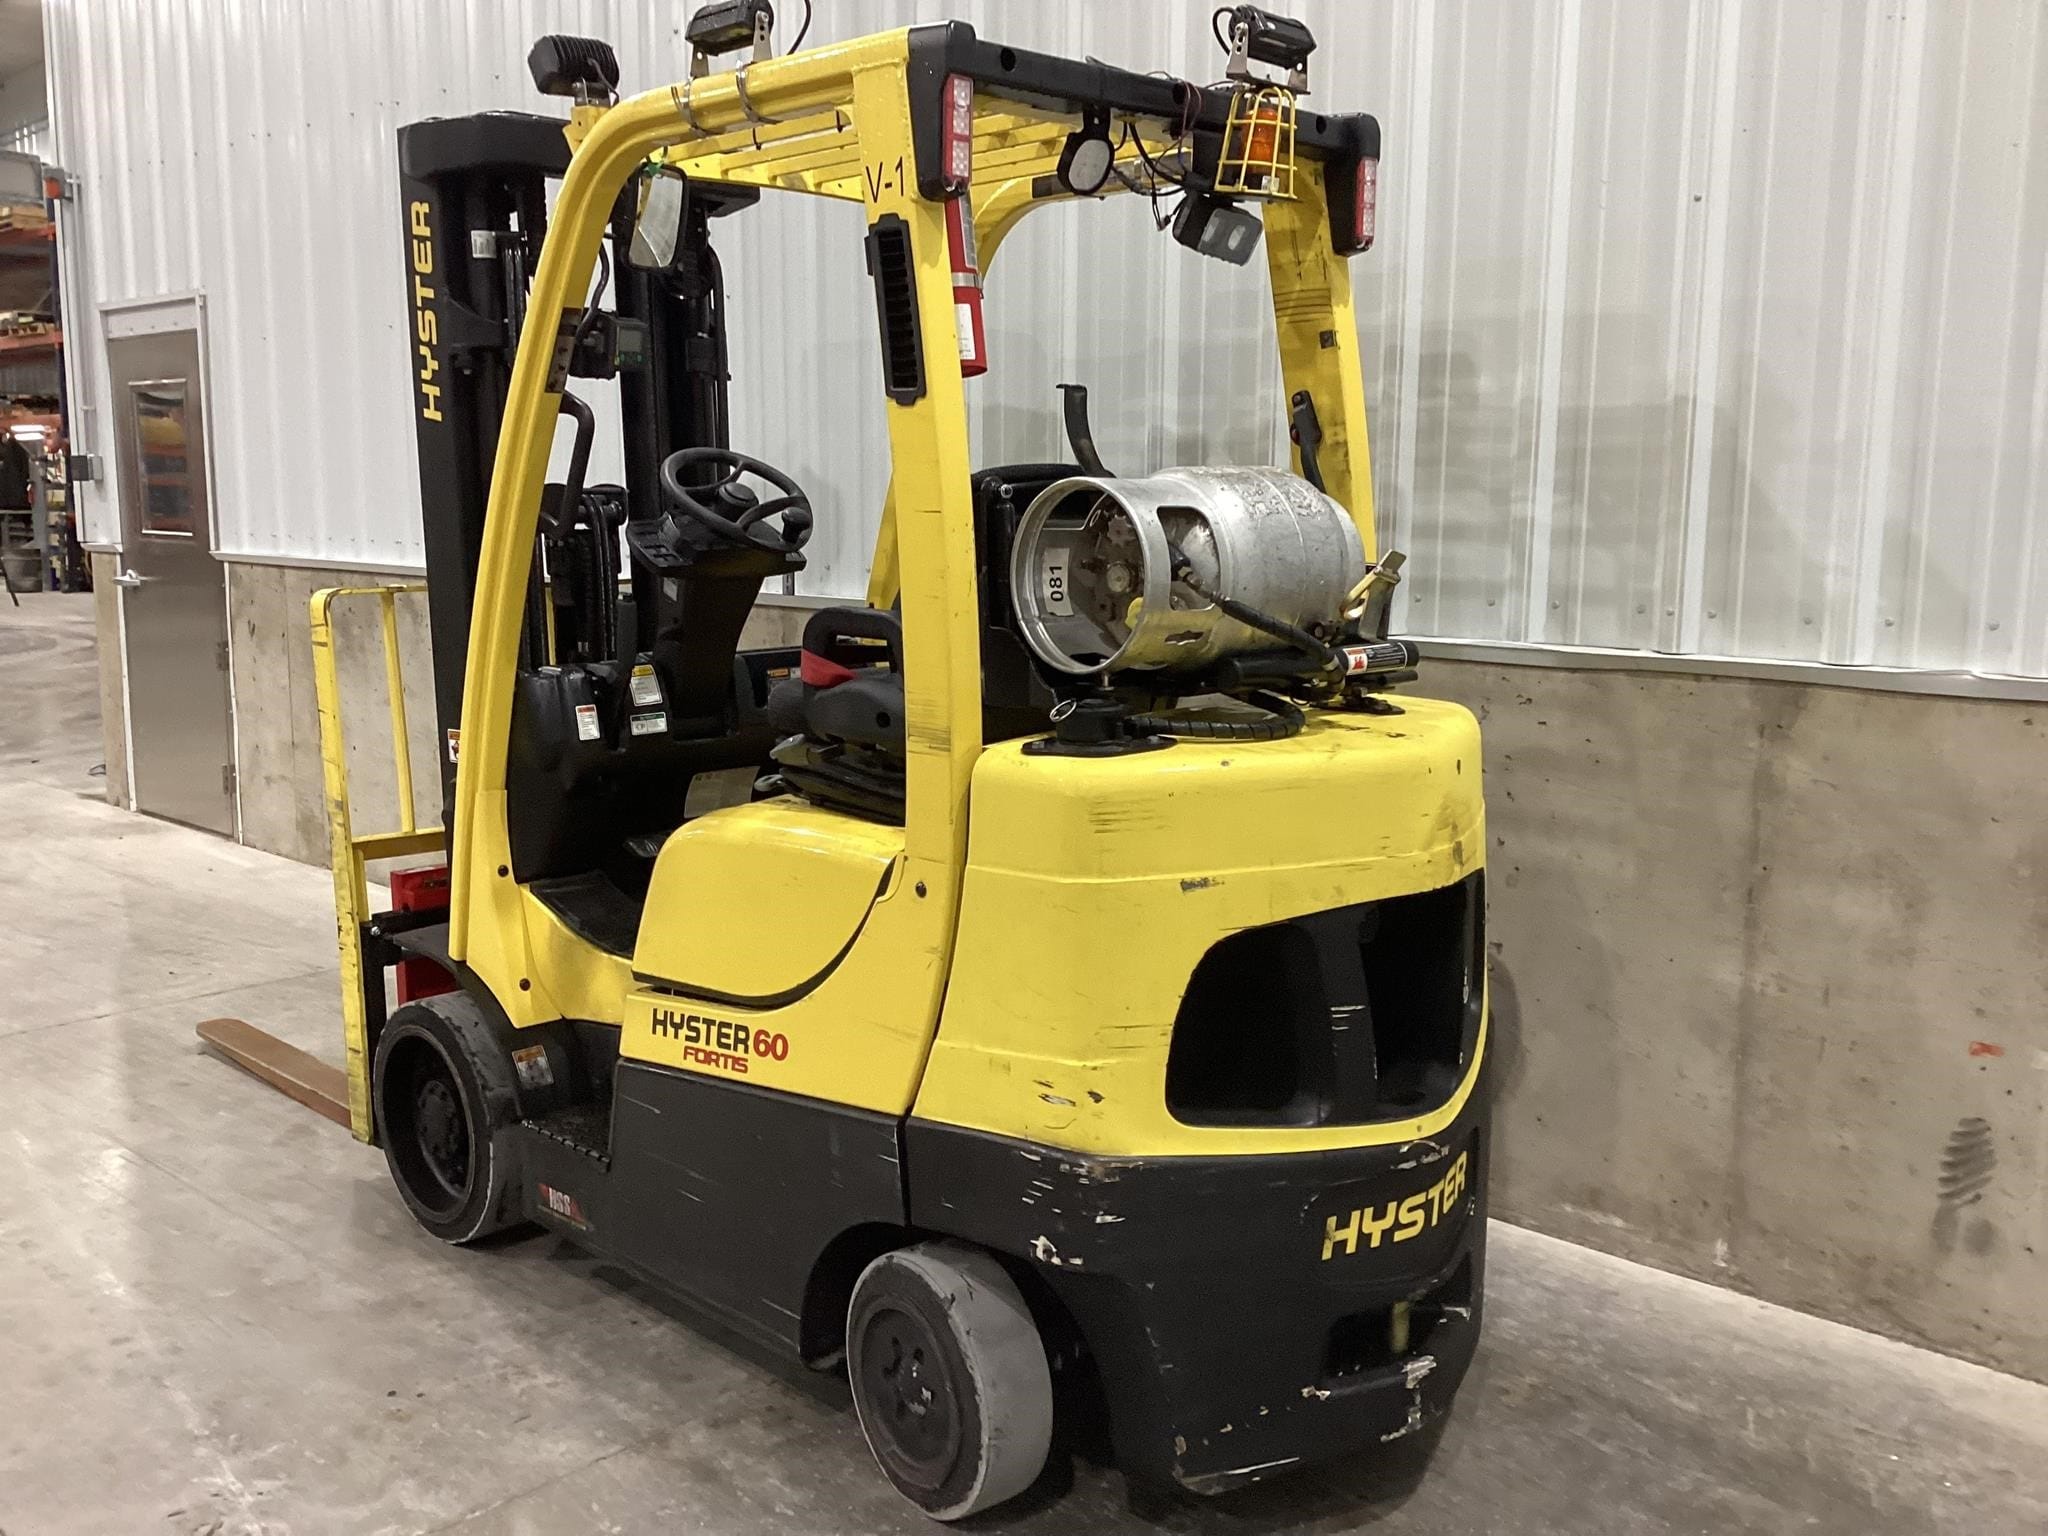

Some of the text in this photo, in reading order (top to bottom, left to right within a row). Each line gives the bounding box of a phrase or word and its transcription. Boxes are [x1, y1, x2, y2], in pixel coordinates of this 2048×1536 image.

[866, 156, 904, 203] V-1
[411, 201, 442, 422] HYSTER
[1049, 566, 1064, 602] 081
[651, 1008, 789, 1061] HYSTER 60
[683, 1045, 749, 1074] FORTIS
[1321, 1150, 1468, 1261] HYSTER
